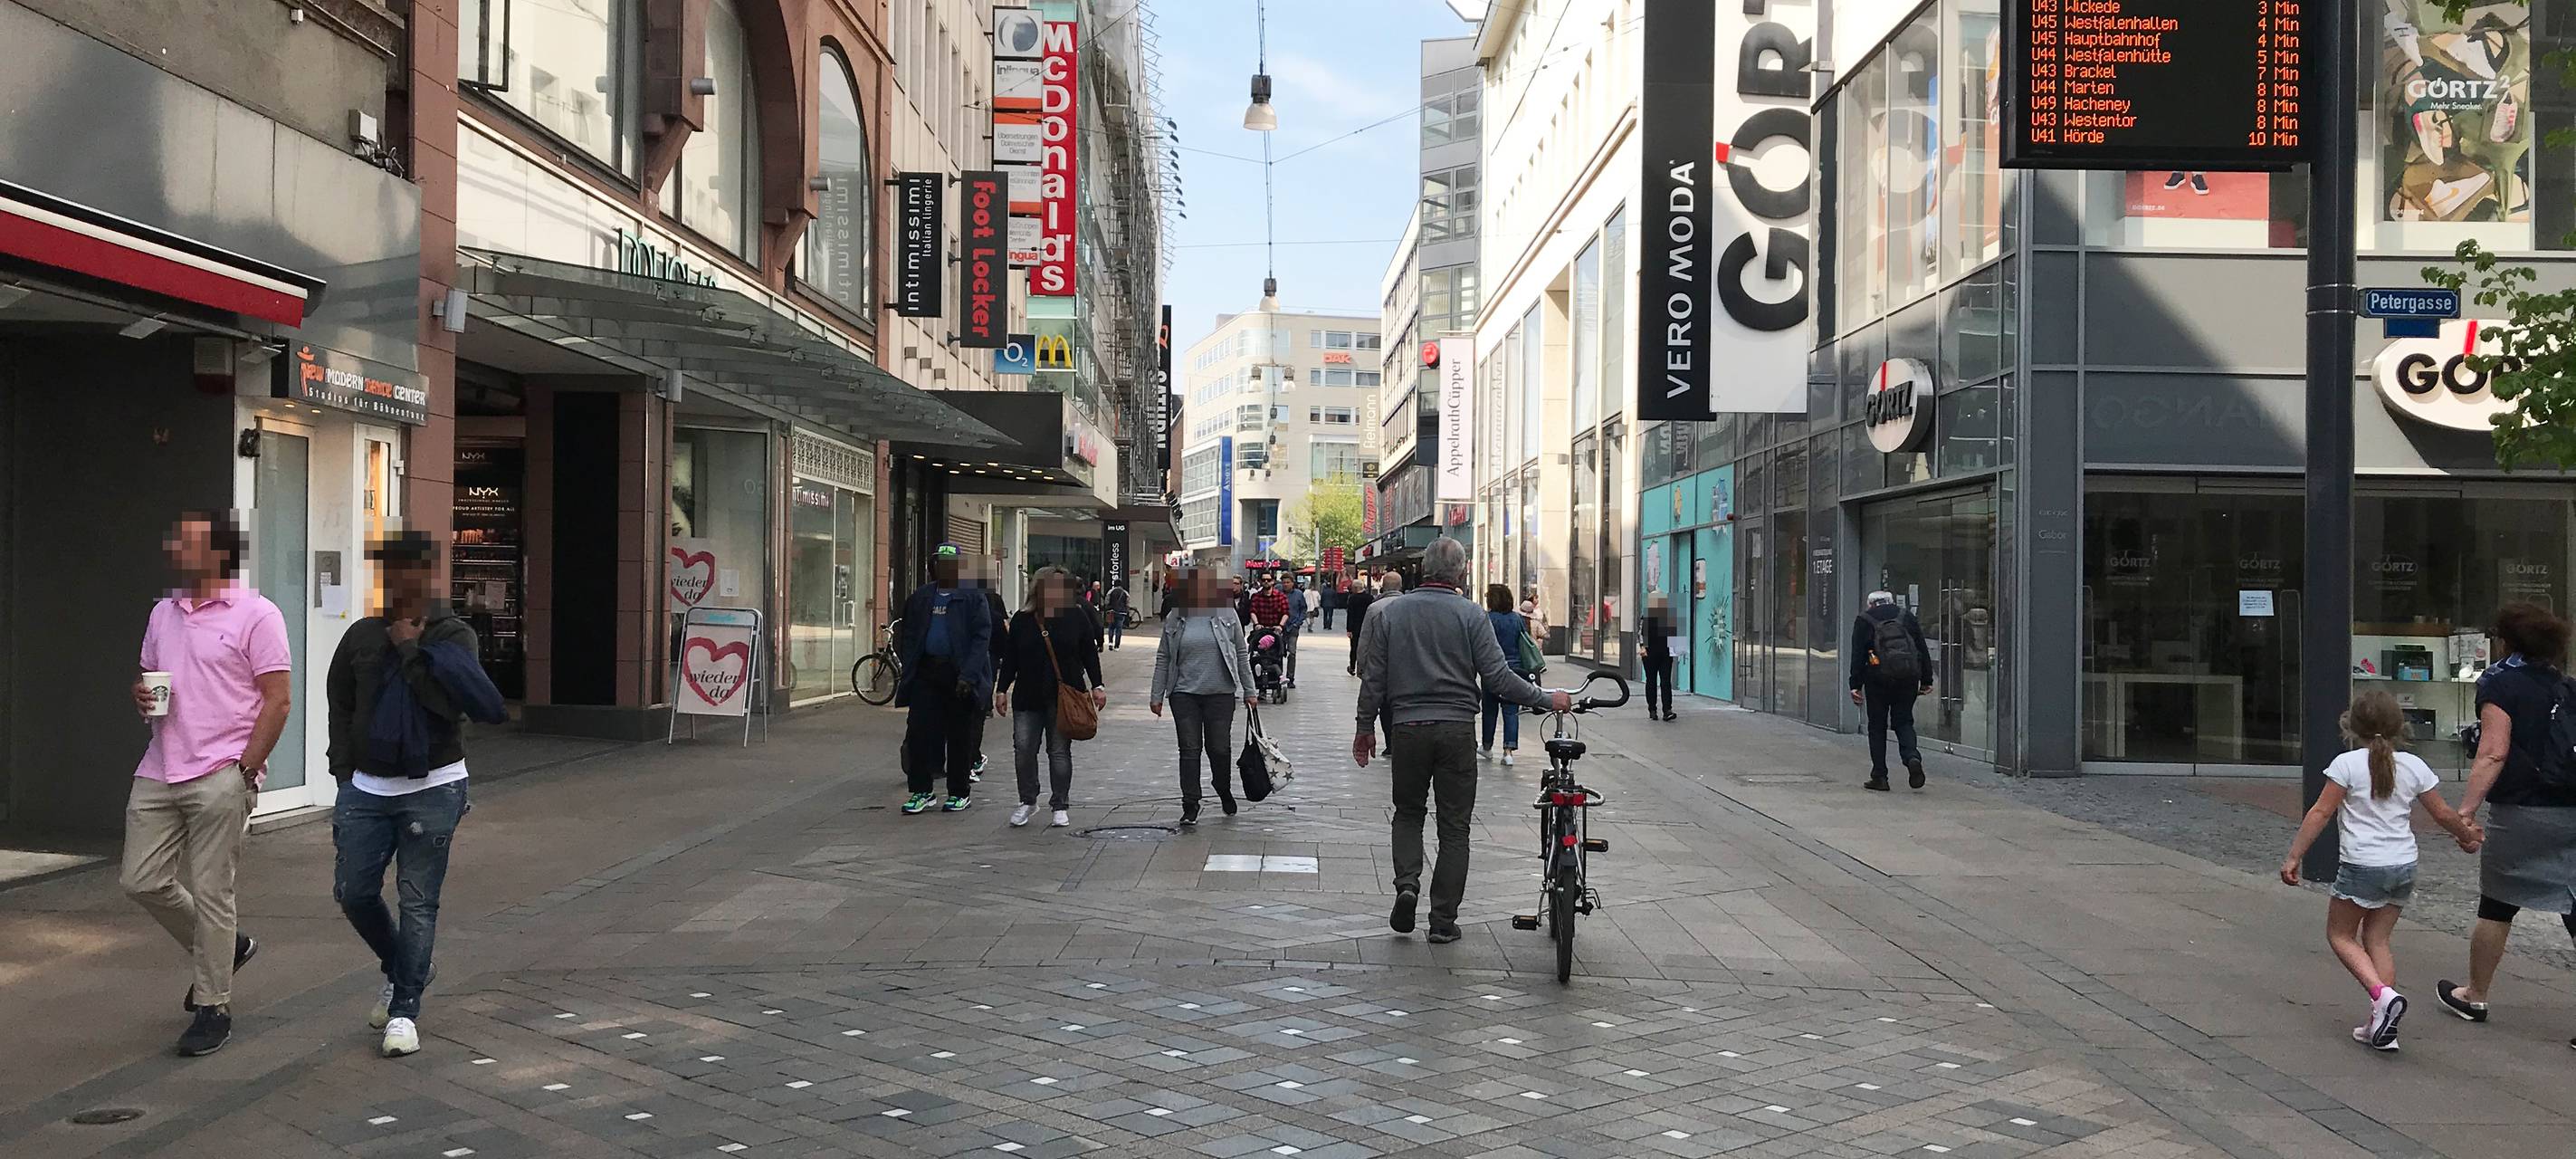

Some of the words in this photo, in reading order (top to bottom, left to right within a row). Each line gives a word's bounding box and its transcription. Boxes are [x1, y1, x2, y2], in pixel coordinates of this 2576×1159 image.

[2032, 0, 2057, 12] U43
[2065, 0, 2121, 13] Wickede
[2258, 1, 2267, 14] 3
[2275, 1, 2299, 14] Min
[2032, 14, 2057, 28] U45
[2065, 14, 2178, 32] Westfalenhallen
[2257, 17, 2267, 31] 4
[2275, 16, 2299, 31] Min
[2032, 31, 2057, 44] U45
[2065, 31, 2161, 49] Hauptbahnhof
[2257, 34, 2267, 47] 4
[2275, 34, 2299, 48] Min
[2031, 47, 2056, 61] U44
[2065, 47, 2171, 64] Westfalenhütte
[2257, 50, 2267, 63] 5
[2275, 50, 2299, 64] Min
[2031, 63, 2056, 77] U43
[2065, 64, 2117, 78] Brackel
[2257, 66, 2266, 81] 7
[2274, 66, 2299, 81] Min
[2031, 80, 2056, 93] U44
[2065, 81, 2114, 94] Marten
[2257, 82, 2266, 97] 8
[2274, 82, 2299, 97] Min
[2031, 96, 2056, 110] U49
[2064, 96, 2131, 113] Hacheney
[2257, 99, 2266, 113] 8
[2274, 99, 2298, 113] Min
[2430, 101, 2450, 110] Mehr
[2031, 112, 2056, 126] U43
[2064, 112, 2137, 127] Westentor
[2256, 115, 2266, 129] 8
[2274, 115, 2298, 129] Min
[2031, 129, 2056, 142] U41
[2064, 129, 2104, 143] Hörde
[2248, 131, 2266, 146] 10
[2273, 131, 2298, 147] Min
[922, 178, 934, 221] lingerie
[972, 180, 996, 239] Foot
[1668, 160, 1695, 282] MODA
[922, 223, 932, 257] Italian
[972, 248, 996, 339] Locker
[2371, 293, 2452, 313] Petergasse
[1666, 292, 1693, 399] VERO
[1323, 351, 1352, 364] DAK
[309, 387, 348, 405] Studios
[354, 395, 368, 408] für
[1446, 358, 1464, 478] AppelrathCüpper
[463, 452, 485, 461] NYX
[469, 487, 499, 499] NYX
[689, 670, 740, 685] wieder
[709, 685, 730, 699] da
